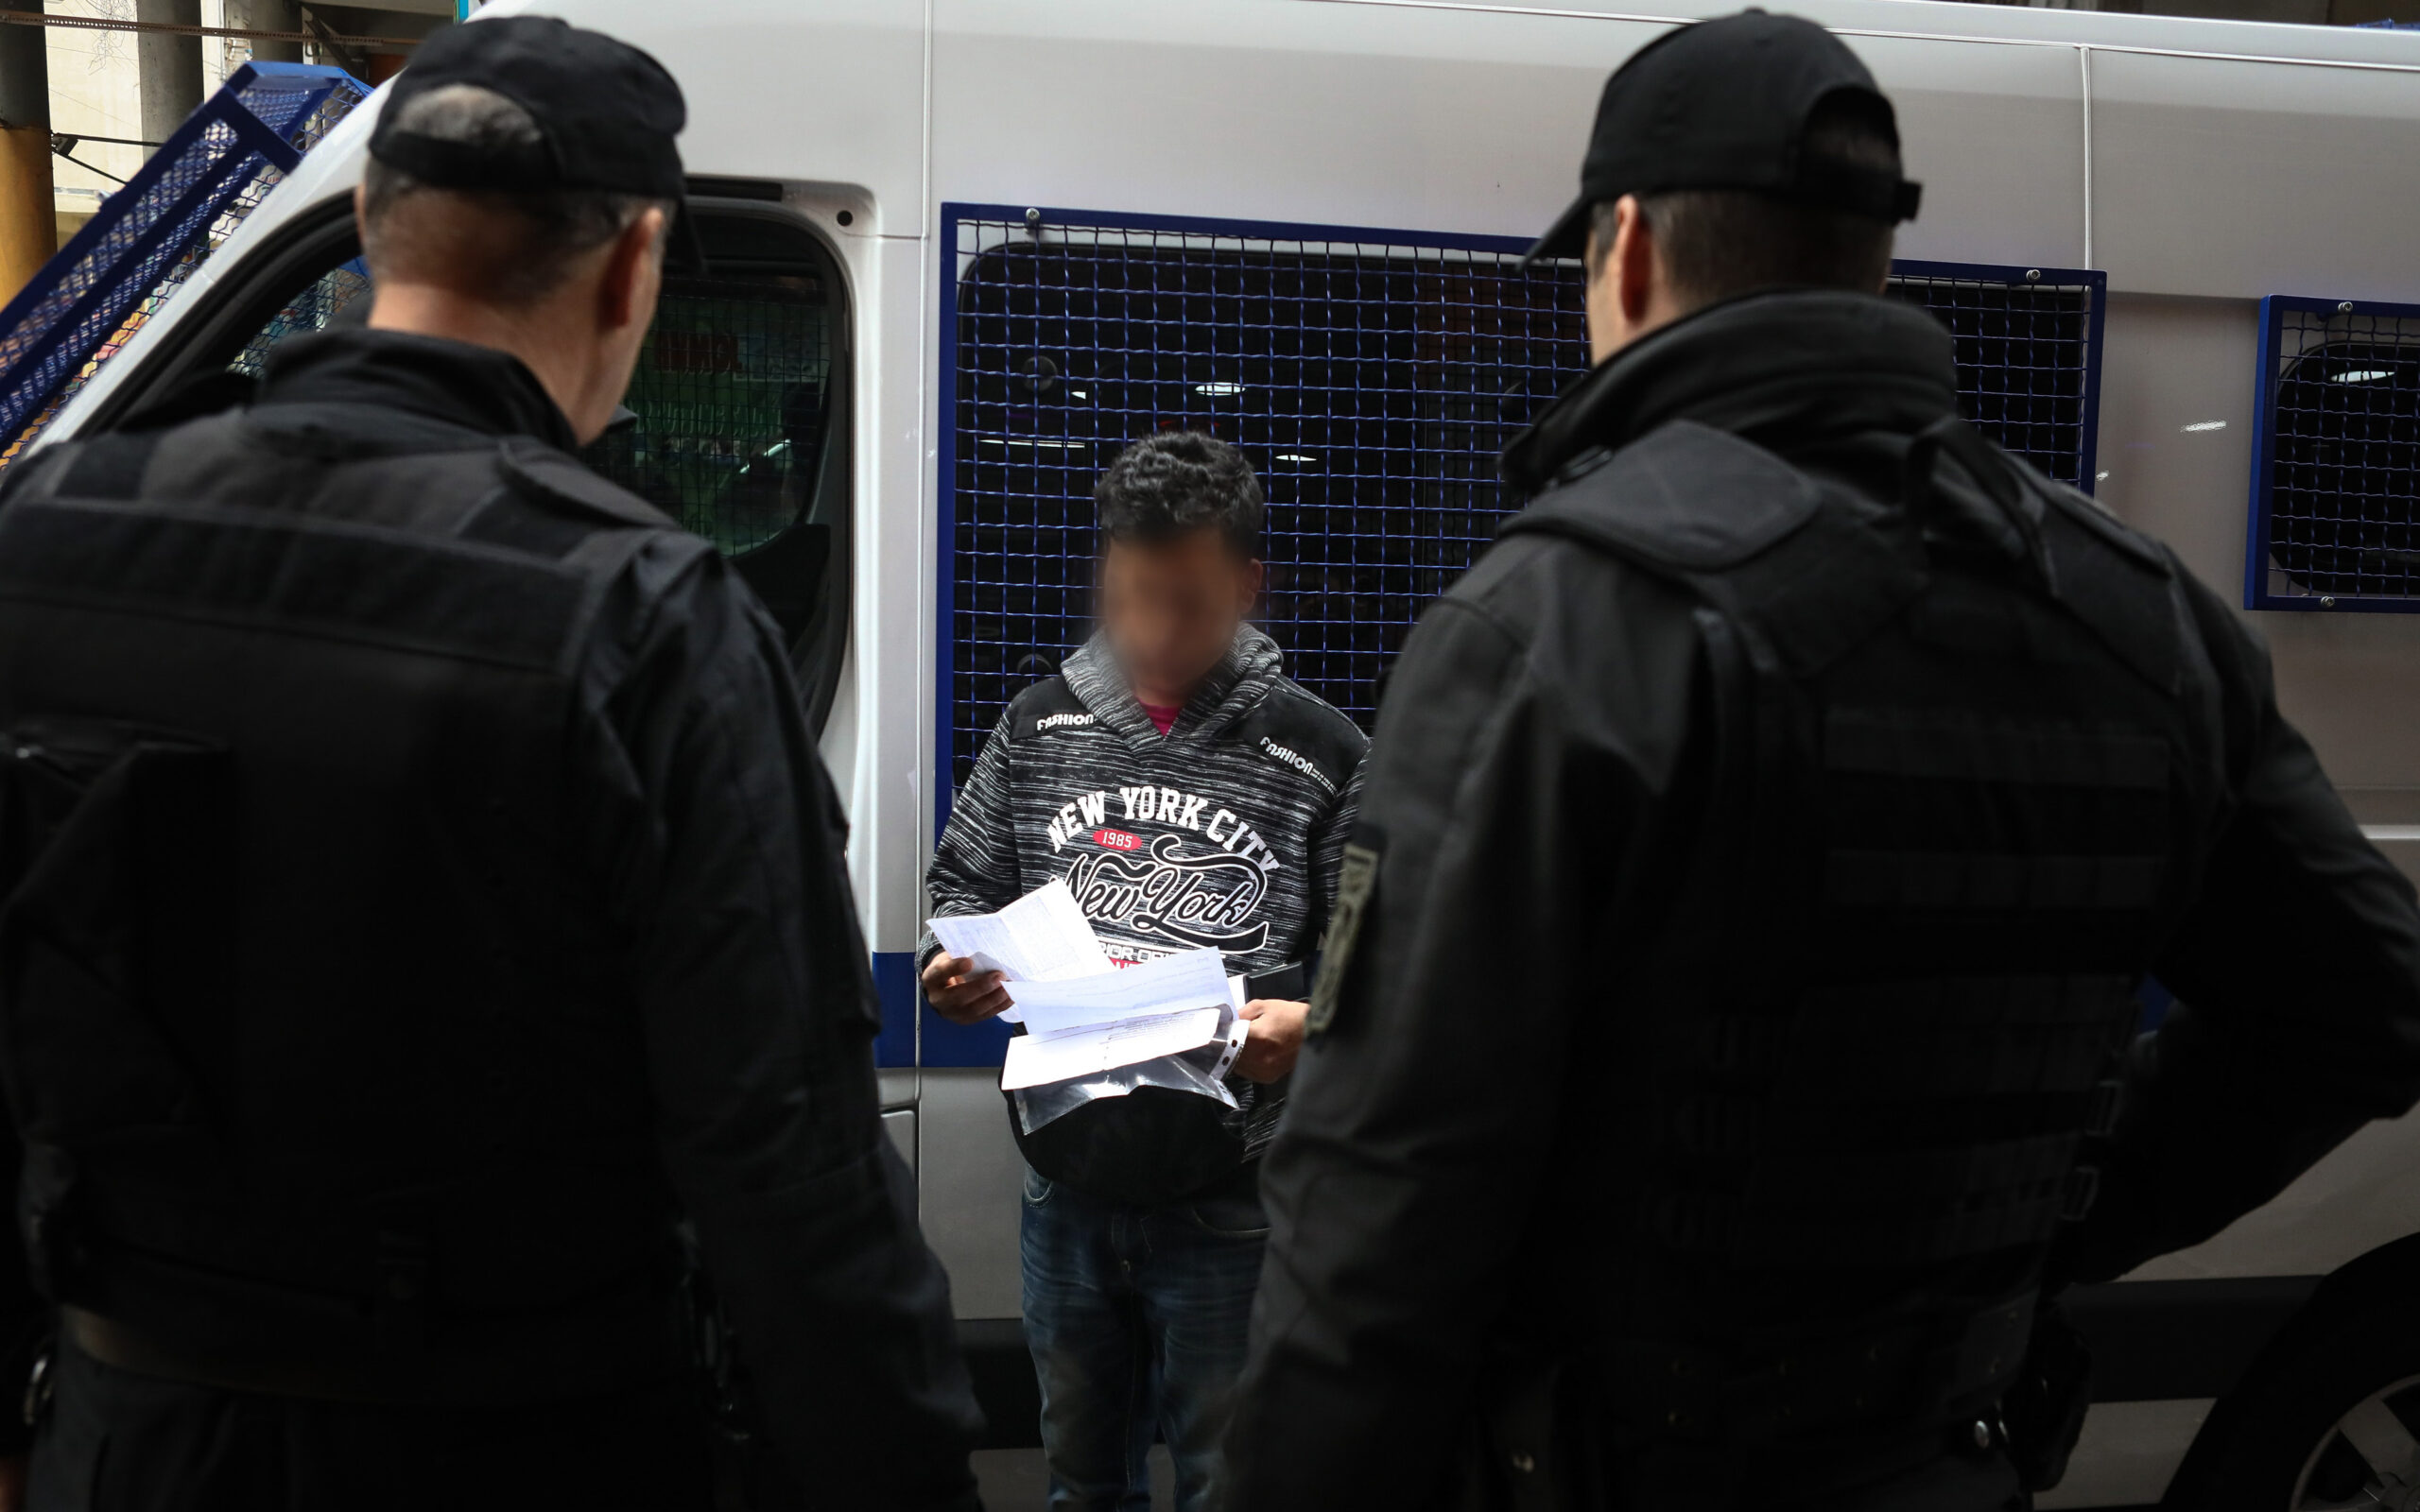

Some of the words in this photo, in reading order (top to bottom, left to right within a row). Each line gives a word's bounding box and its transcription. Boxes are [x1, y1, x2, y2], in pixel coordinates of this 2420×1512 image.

[1037, 713, 1094, 730] FASHION
[1260, 737, 1313, 775] FASHION
[1046, 791, 1106, 853] NEW
[1119, 785, 1209, 831] YORK
[1206, 809, 1280, 879] CITY
[1102, 832, 1133, 849] 1985
[1049, 852, 1158, 920] New
[1137, 843, 1269, 949] York
